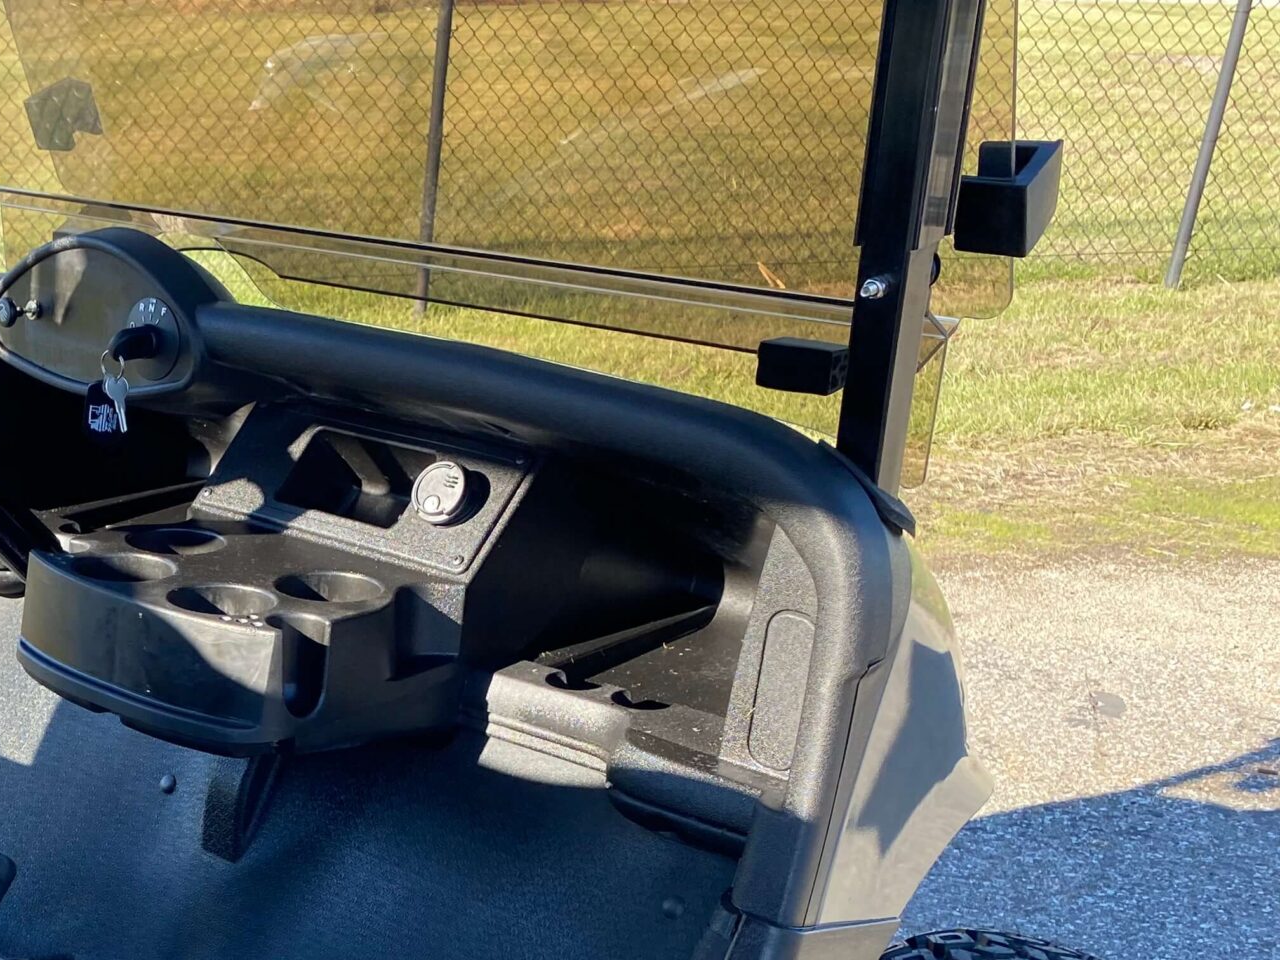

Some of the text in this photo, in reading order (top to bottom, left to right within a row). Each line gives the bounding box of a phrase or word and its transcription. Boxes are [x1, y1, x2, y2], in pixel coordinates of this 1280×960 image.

[139, 302, 145, 312] R
[148, 303, 155, 313] N
[161, 307, 167, 316] F
